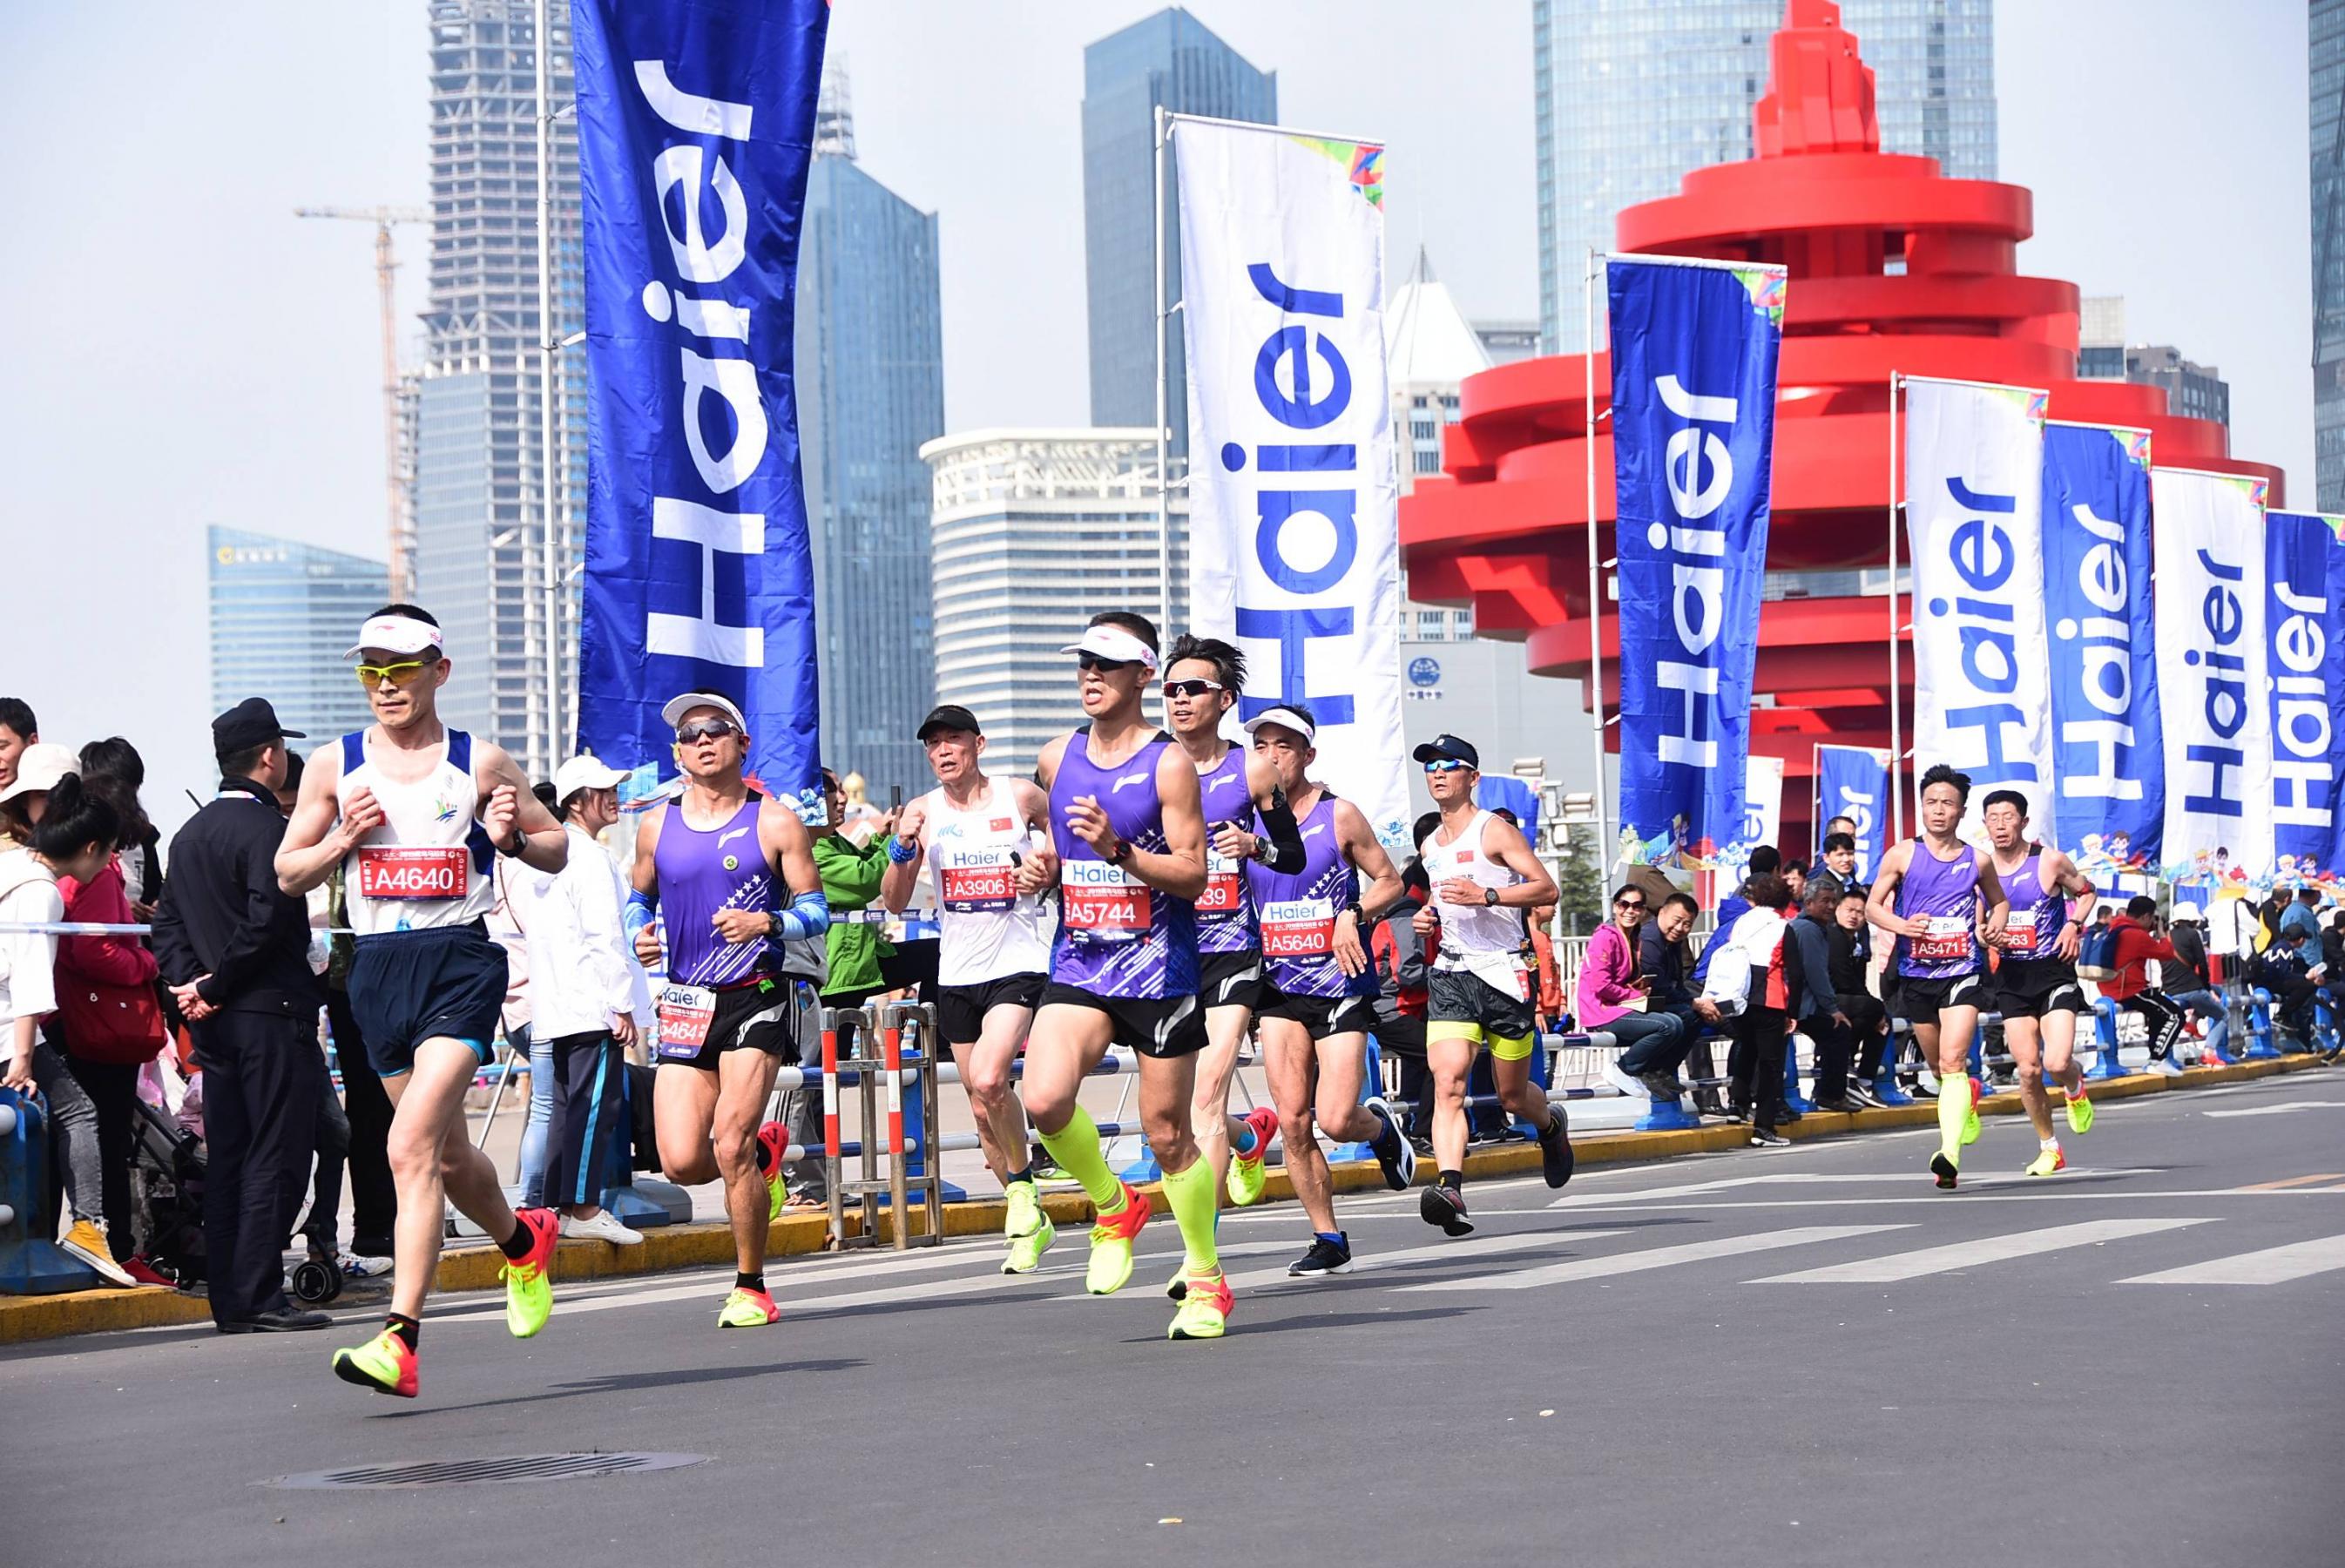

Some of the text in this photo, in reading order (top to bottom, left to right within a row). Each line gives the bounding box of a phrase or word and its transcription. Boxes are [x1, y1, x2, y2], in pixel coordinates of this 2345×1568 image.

[634, 59, 767, 668] Haier
[1221, 263, 1358, 726] Haier
[1647, 375, 1737, 767] Haier
[1929, 476, 2037, 787] Haier
[2057, 504, 2143, 800] Haier
[2184, 549, 2247, 817] Haier
[2267, 582, 2333, 827] Haier
[954, 851, 1000, 866] Haier
[375, 868, 453, 889] A4640
[1072, 864, 1126, 883] Haier
[954, 879, 1005, 896] A3906
[1071, 902, 1136, 923] A5744
[1270, 904, 1316, 920] Haier
[1271, 933, 1325, 951] A5640
[1918, 942, 1958, 955] A5471
